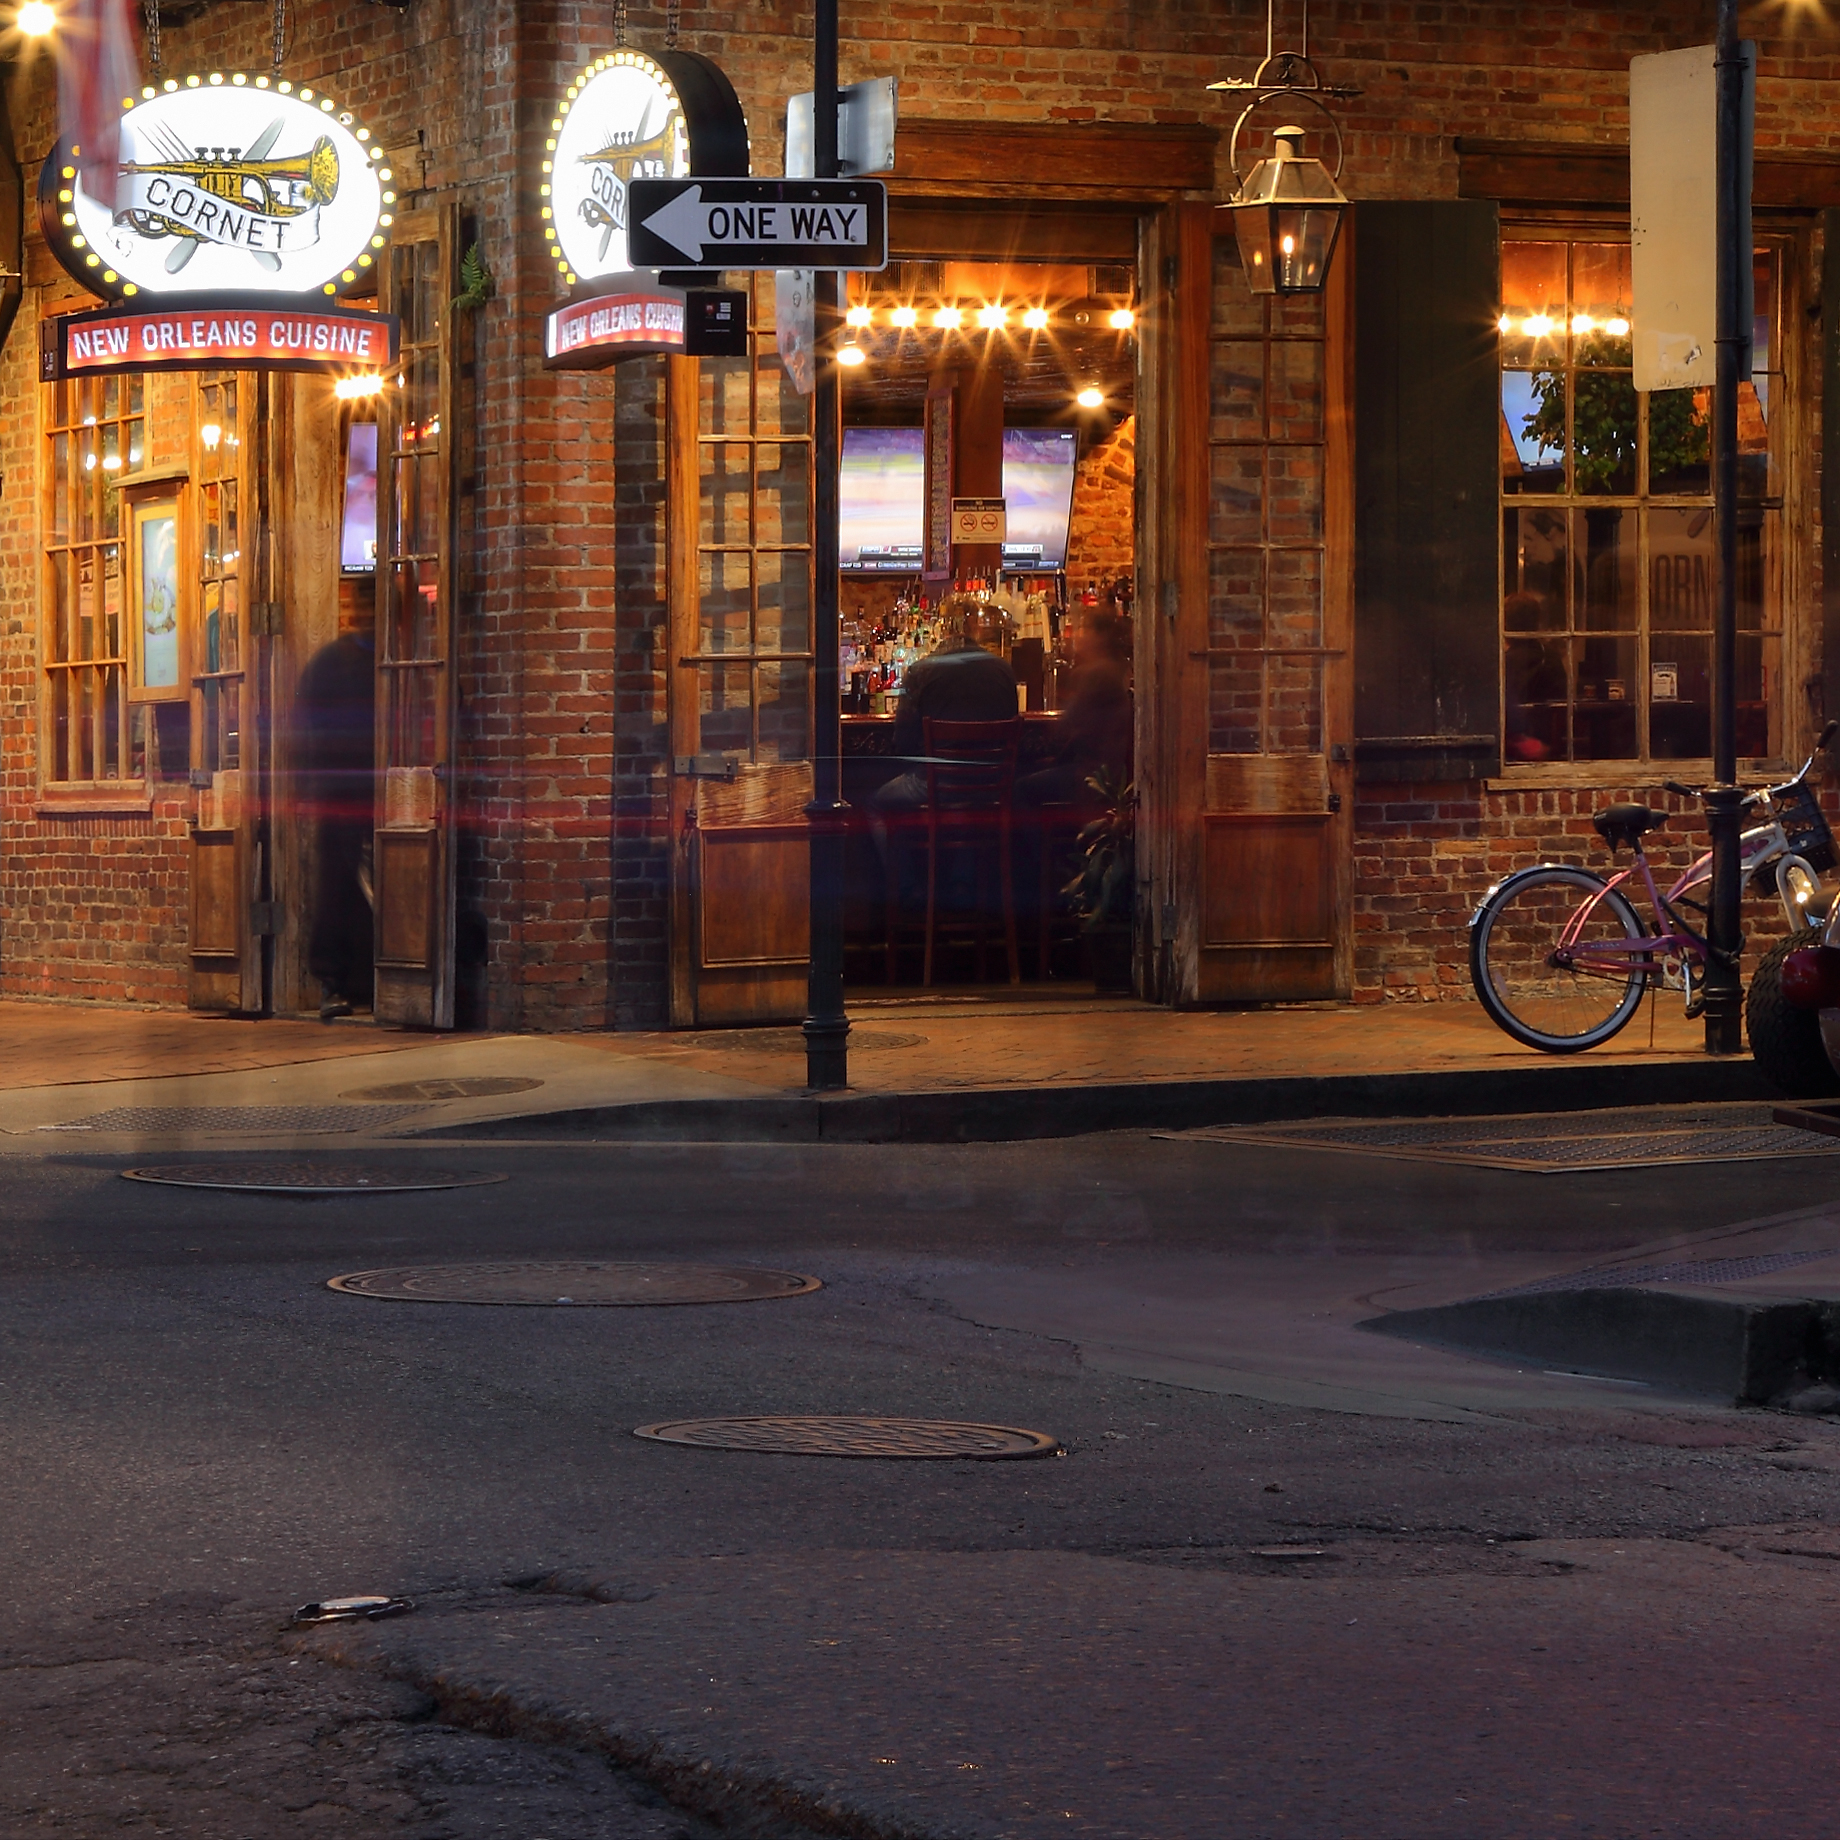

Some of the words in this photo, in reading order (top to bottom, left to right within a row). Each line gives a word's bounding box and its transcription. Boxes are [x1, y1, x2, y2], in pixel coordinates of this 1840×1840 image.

[145, 177, 291, 250] CORNET
[708, 207, 778, 240] ONE
[791, 207, 859, 241] WAY
[73, 326, 129, 359] NEW
[142, 320, 256, 353] ORLEANS
[269, 320, 372, 356] CUISINE
[562, 315, 587, 351] NEW
[590, 303, 642, 338] ORLEANS
